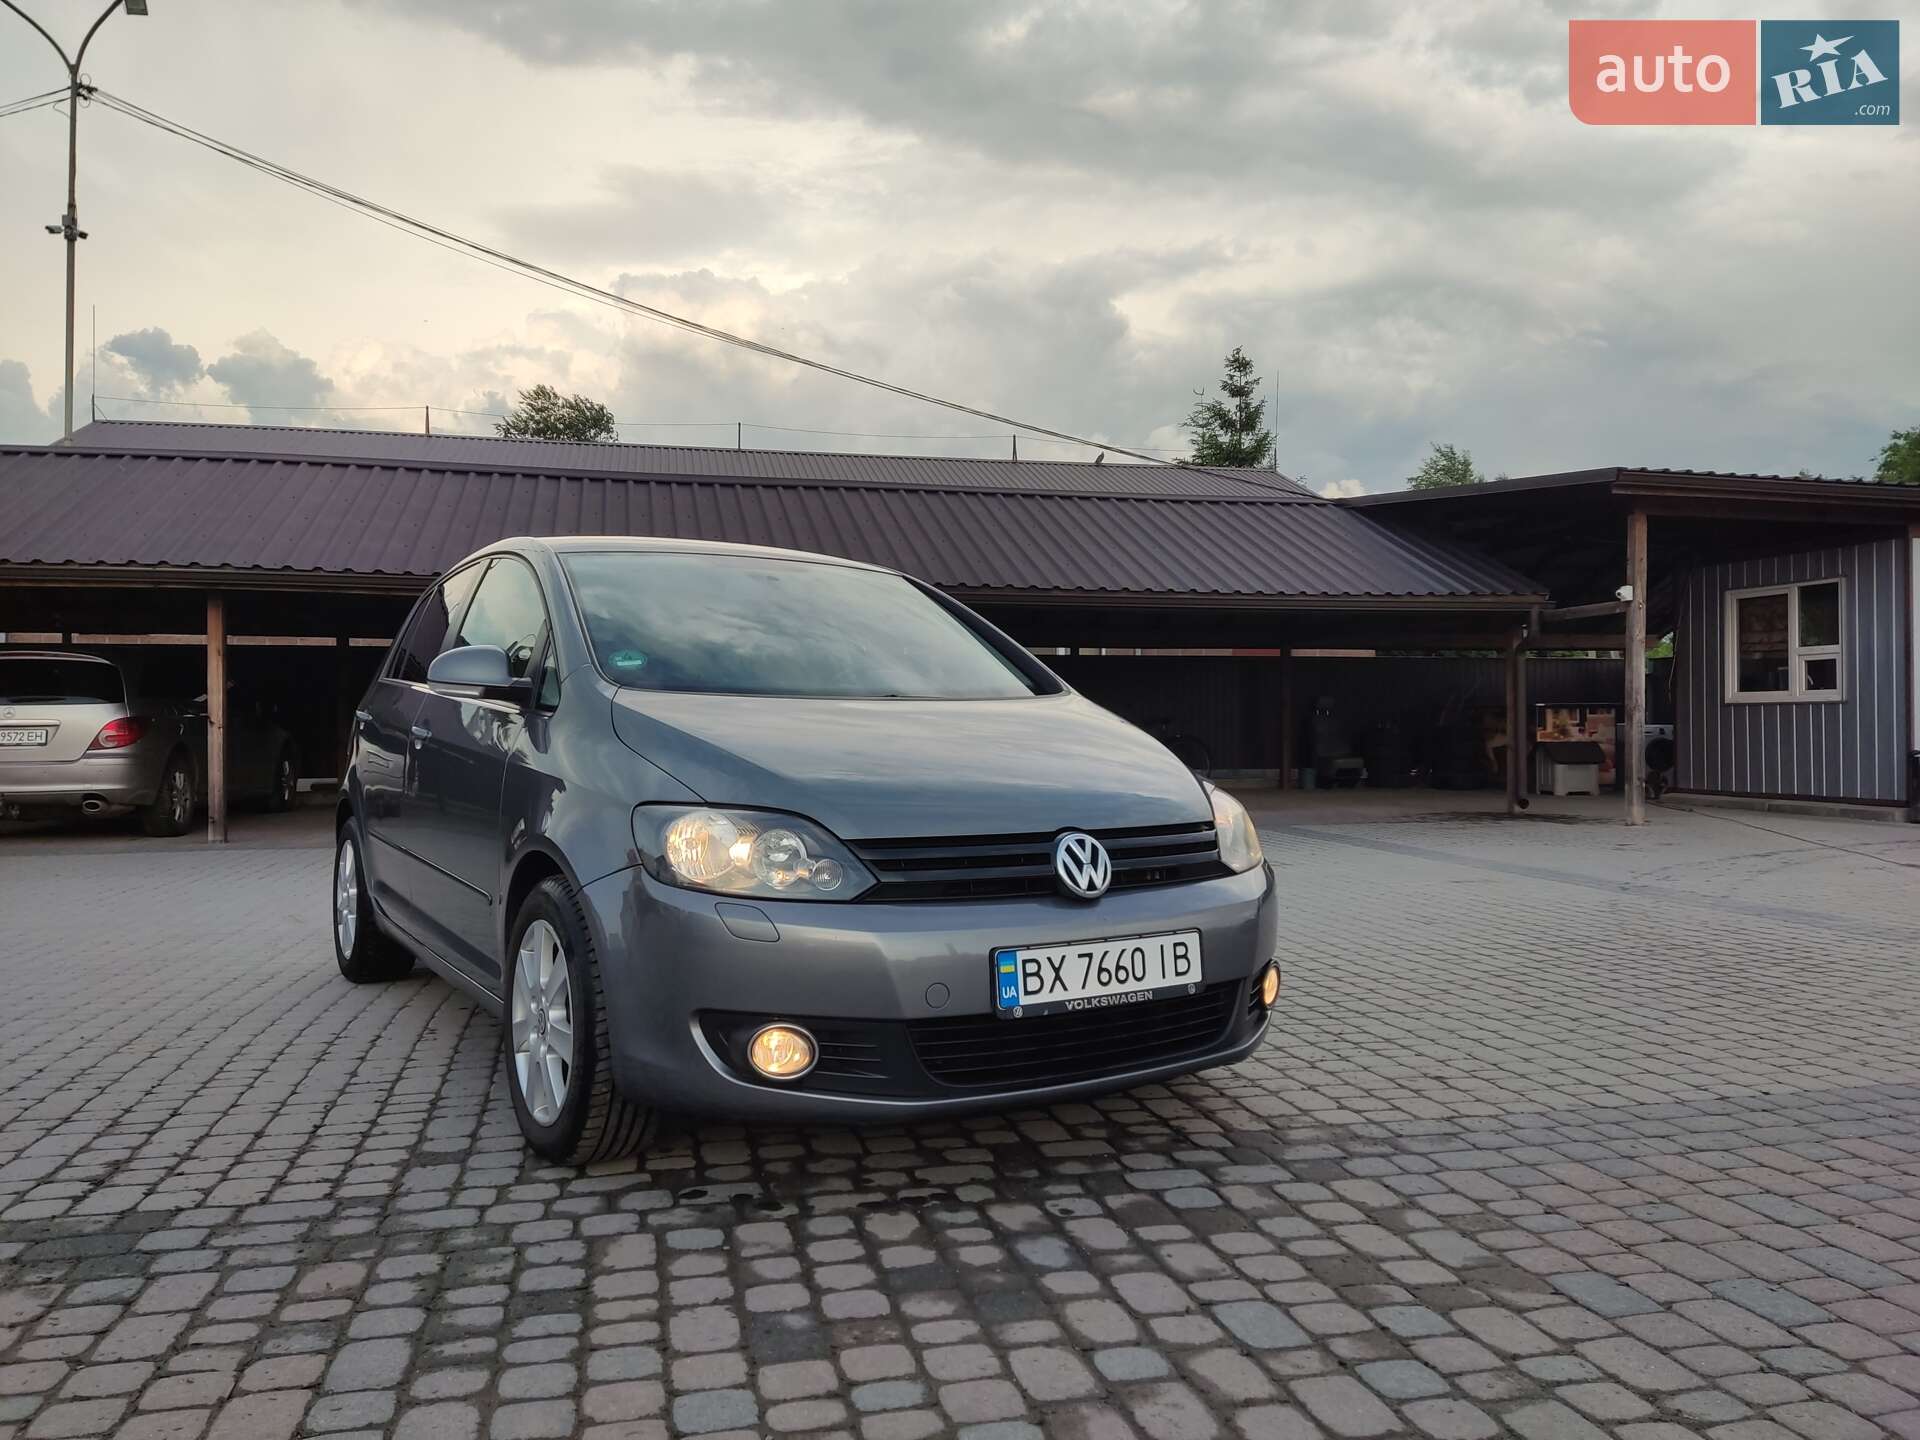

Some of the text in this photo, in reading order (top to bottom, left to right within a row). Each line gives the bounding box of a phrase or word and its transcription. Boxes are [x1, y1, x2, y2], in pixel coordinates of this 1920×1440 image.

[0, 731, 43, 742] 9572 EH
[1021, 941, 1191, 996] BX 7660 IB
[1002, 985, 1017, 999] UA
[1065, 990, 1153, 1011] VOLKSWAGEN
